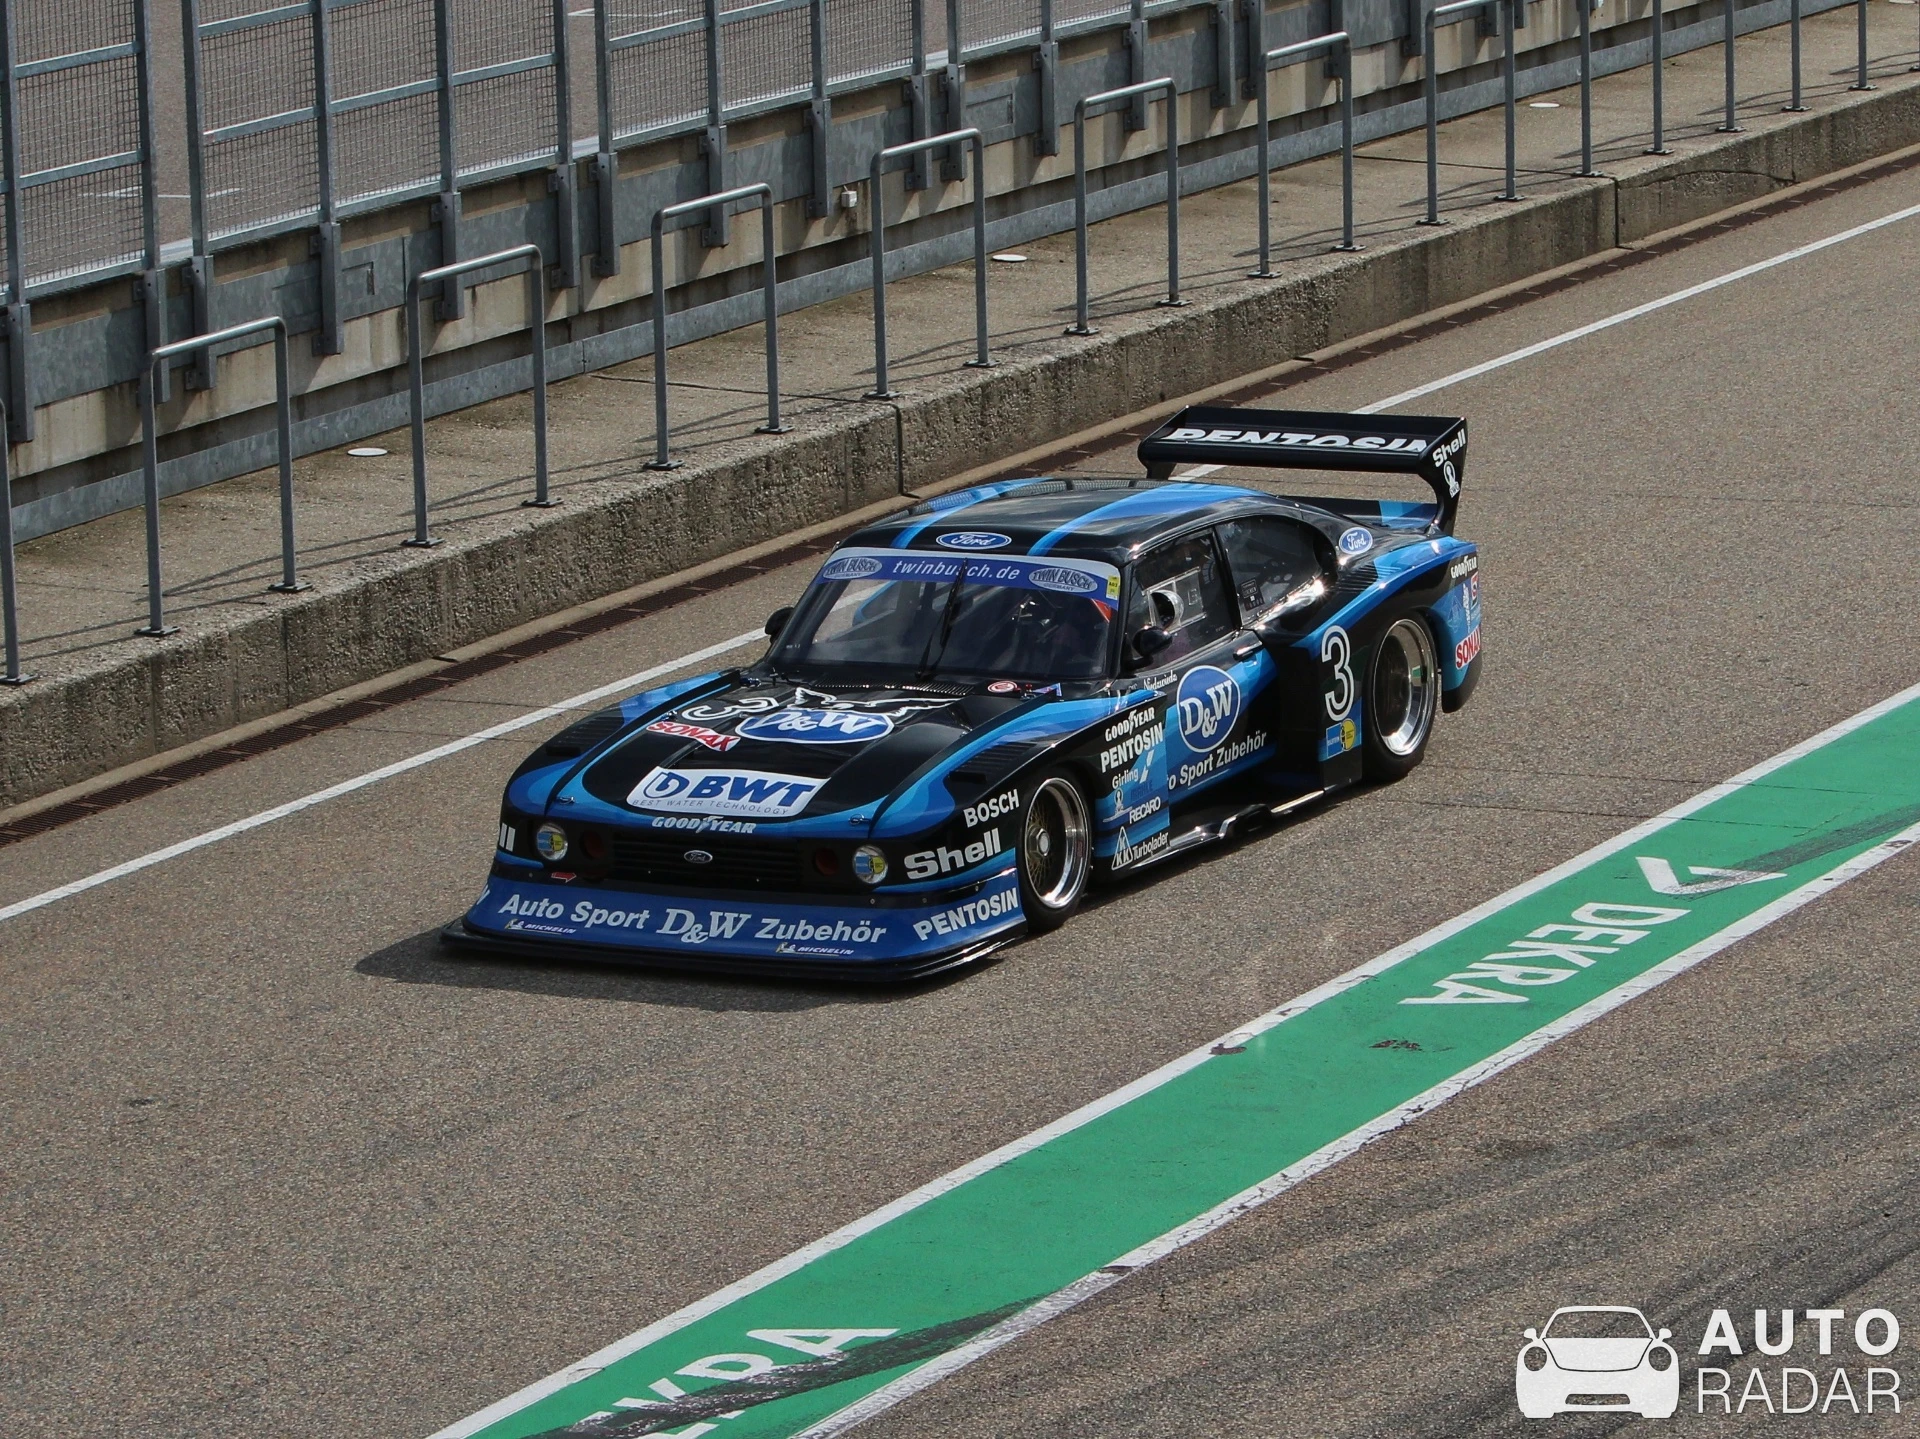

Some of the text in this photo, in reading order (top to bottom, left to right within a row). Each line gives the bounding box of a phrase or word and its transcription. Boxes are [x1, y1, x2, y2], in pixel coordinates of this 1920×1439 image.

[1161, 428, 1428, 452] PENTOSIN
[1433, 428, 1466, 467] Shell
[847, 558, 878, 573] BUSCH
[1032, 569, 1092, 590] TWIN BUSCH
[1451, 555, 1477, 578] GOODYEAR
[1321, 625, 1355, 722] 3
[745, 711, 886, 735] D&W
[1180, 679, 1232, 738] D&W
[649, 721, 732, 751] SONAX
[1105, 707, 1155, 741] GOODYEAR
[1100, 722, 1164, 773] PENTOSIN
[1180, 753, 1214, 786] Sport
[1216, 730, 1267, 768] Zubehör
[687, 775, 816, 807] BWT
[1112, 768, 1139, 789] Girling
[632, 799, 789, 815] BEST WATER TECHNOLOGY
[963, 789, 1020, 828] BOSCH
[1129, 796, 1161, 824] RECARO
[651, 815, 757, 833] GOODYEAR
[904, 828, 1001, 880] Shell
[1132, 832, 1169, 860] Turbolader
[498, 894, 887, 944] Auto Sport D&W Zubehör
[524, 923, 577, 934] MICHELIN
[913, 887, 1019, 941] PENTOSIN
[797, 946, 855, 955] MICHELIN
[1397, 902, 1692, 1005] DEKRA
